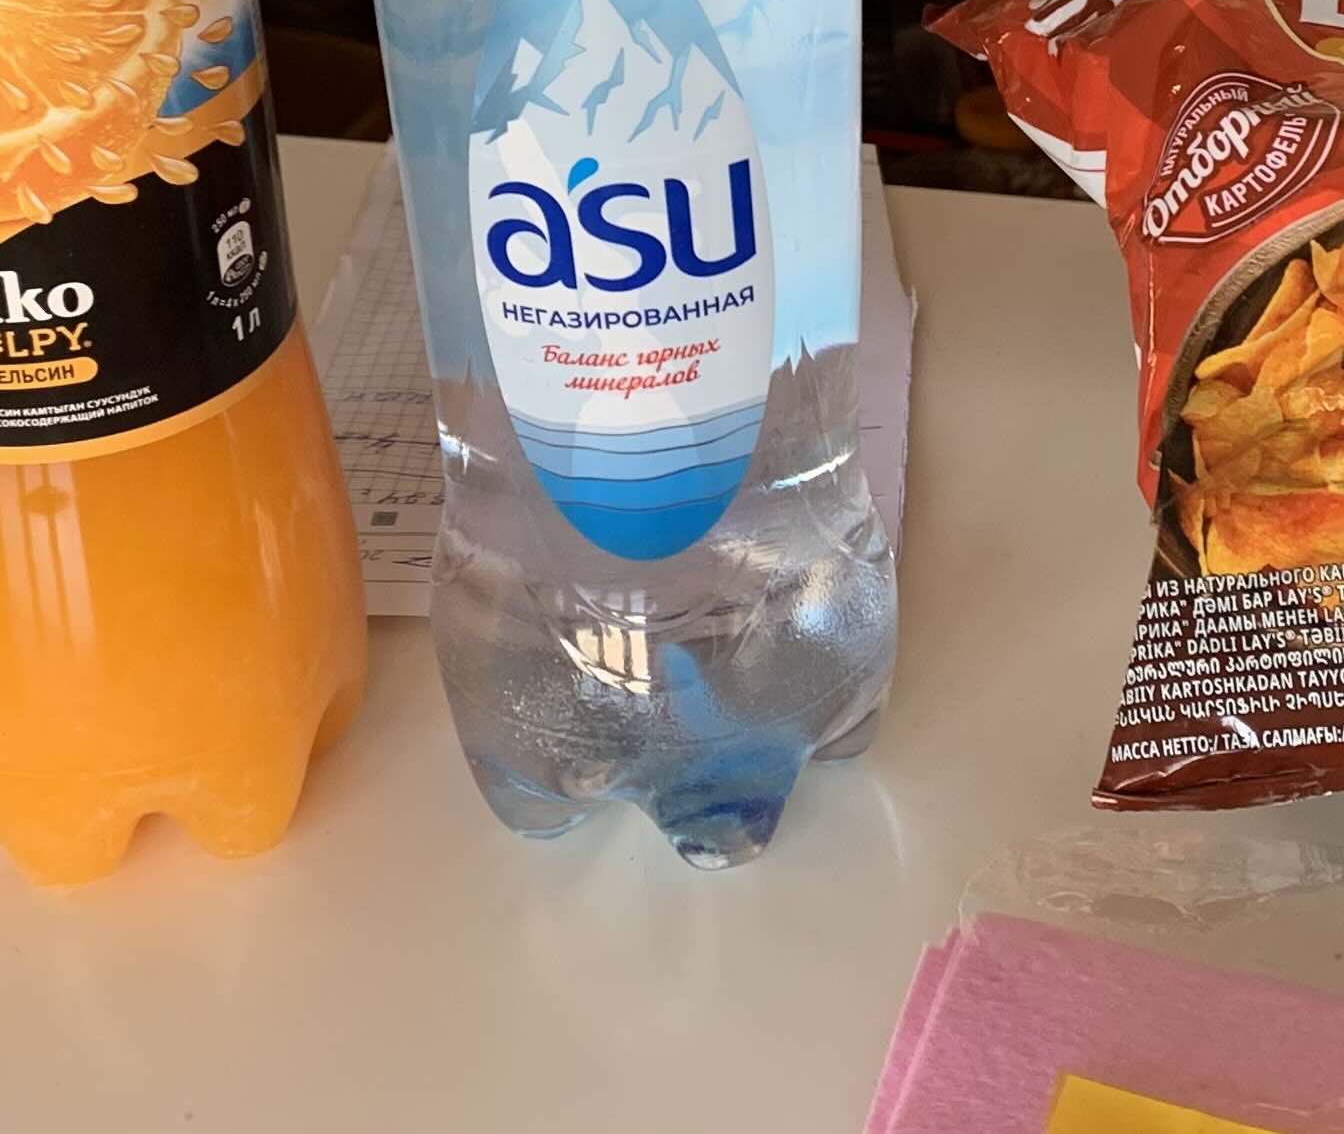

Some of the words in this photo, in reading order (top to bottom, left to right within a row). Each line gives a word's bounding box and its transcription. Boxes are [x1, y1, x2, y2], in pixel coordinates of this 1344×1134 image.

[1160, 87, 1250, 177] НАТУРАЛЬНЫЙ
[1142, 83, 1322, 238] Отборный
[1204, 113, 1309, 217] КАРТОФЕЛЬ
[502, 286, 755, 330] НЕГАЗИРОВАННАЯ
[542, 345, 630, 367] Баланс
[637, 338, 721, 373] горных
[564, 360, 701, 399] минералов
[23, 401, 85, 417] КАМТЫГАН
[87, 386, 152, 410] СУУСУНДУК
[107, 393, 160, 415] НАПИТОК
[1157, 581, 1179, 598] ИЗ
[1184, 568, 1314, 594] НАТУРАЛЬНОГО
[1243, 592, 1273, 611] БАР
[1194, 618, 1256, 638] ДААМЫ
[1261, 609, 1318, 629] МЕНЕН
[1187, 636, 1237, 656] DADLI
[1120, 687, 1155, 707] ABIIY
[1161, 672, 1292, 701] KARTOSHKADAN
[1112, 742, 1157, 763] МАССА
